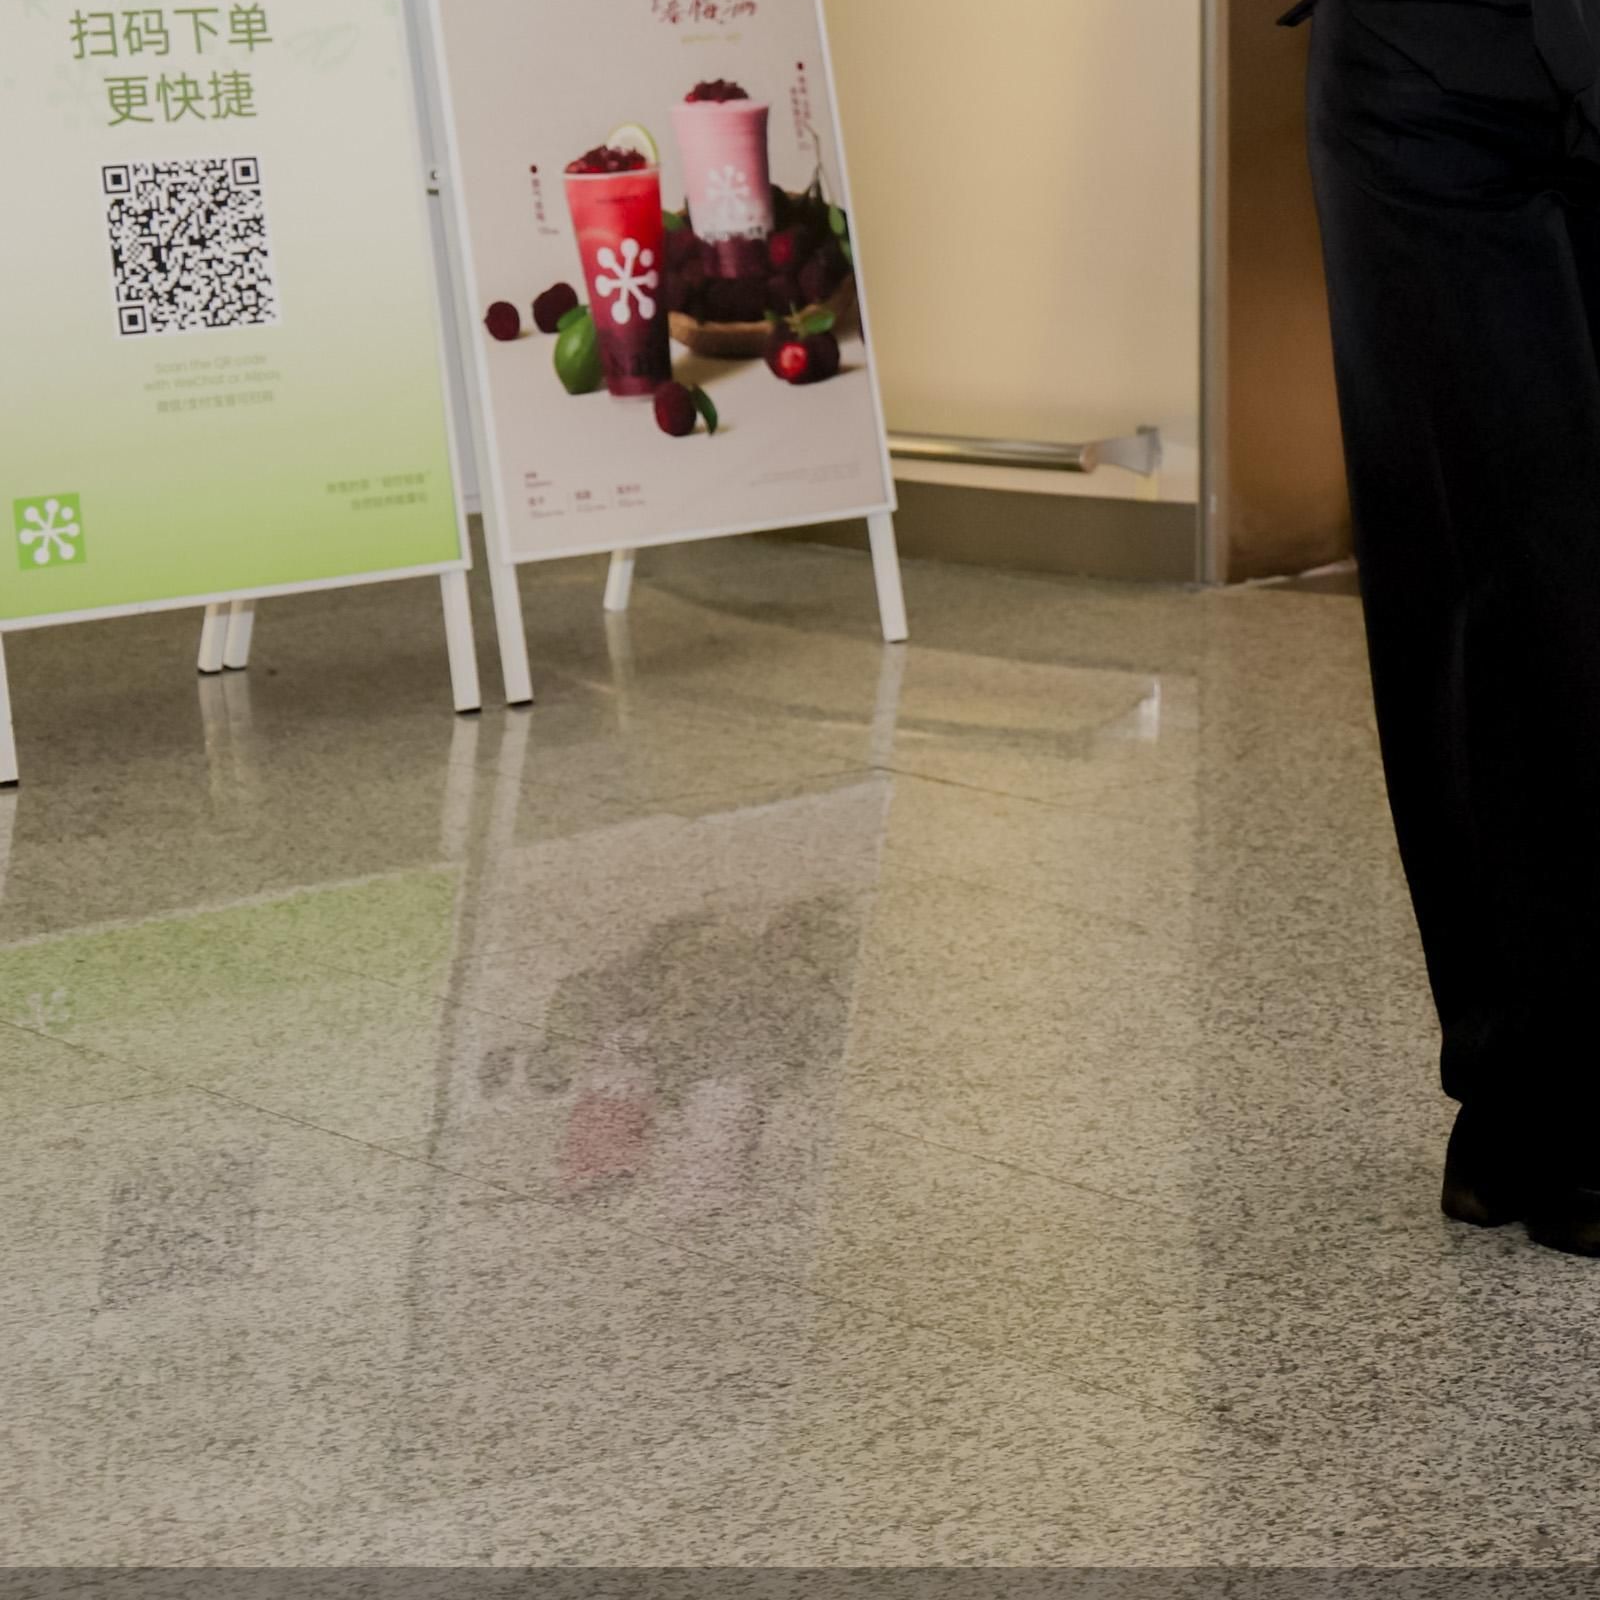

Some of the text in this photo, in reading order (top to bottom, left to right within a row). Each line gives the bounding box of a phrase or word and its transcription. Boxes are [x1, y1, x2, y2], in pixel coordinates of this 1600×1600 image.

[69, 3, 274, 60] 扫码下单
[103, 70, 258, 127] 更快捷
